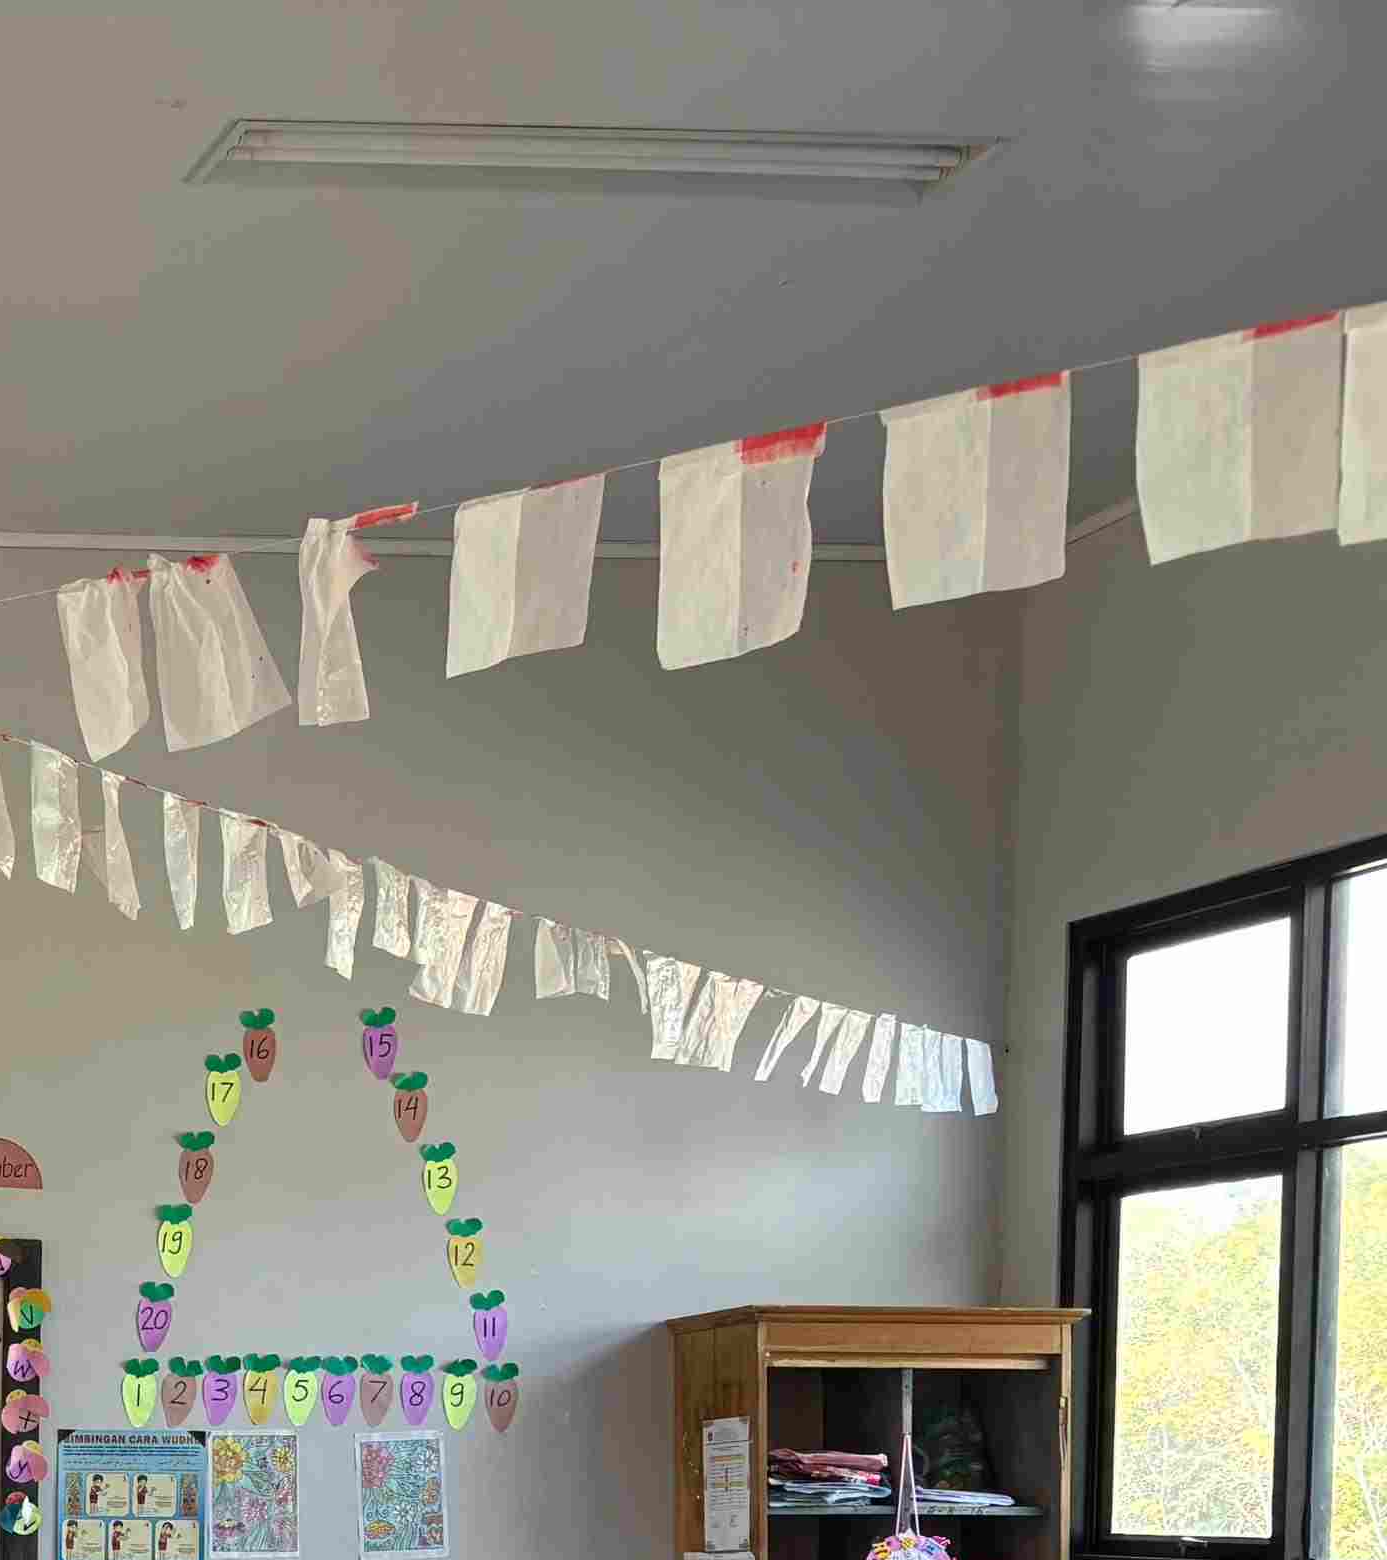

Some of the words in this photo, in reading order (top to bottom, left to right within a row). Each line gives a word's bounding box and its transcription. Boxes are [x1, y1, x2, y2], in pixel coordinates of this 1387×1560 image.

[249, 1038, 270, 1060] 16
[369, 1034, 392, 1057] 15
[211, 1082, 235, 1103] 17
[397, 1095, 419, 1121] 14
[185, 1157, 208, 1181] 18
[427, 1166, 452, 1190] 13
[162, 1230, 183, 1255] 19
[454, 1242, 475, 1267] 12
[141, 1306, 169, 1331] 20
[483, 1317, 497, 1338] 11
[136, 1384, 141, 1407] 1
[171, 1381, 187, 1405] 2
[212, 1379, 229, 1401] 3
[248, 1376, 268, 1404] 4
[293, 1379, 309, 1402] 5
[329, 1381, 345, 1404] 6
[370, 1380, 388, 1403] 7
[410, 1380, 425, 1406] 8
[450, 1383, 464, 1408] 9
[490, 1388, 511, 1407] 10
[129, 1433, 158, 1444] CARA
